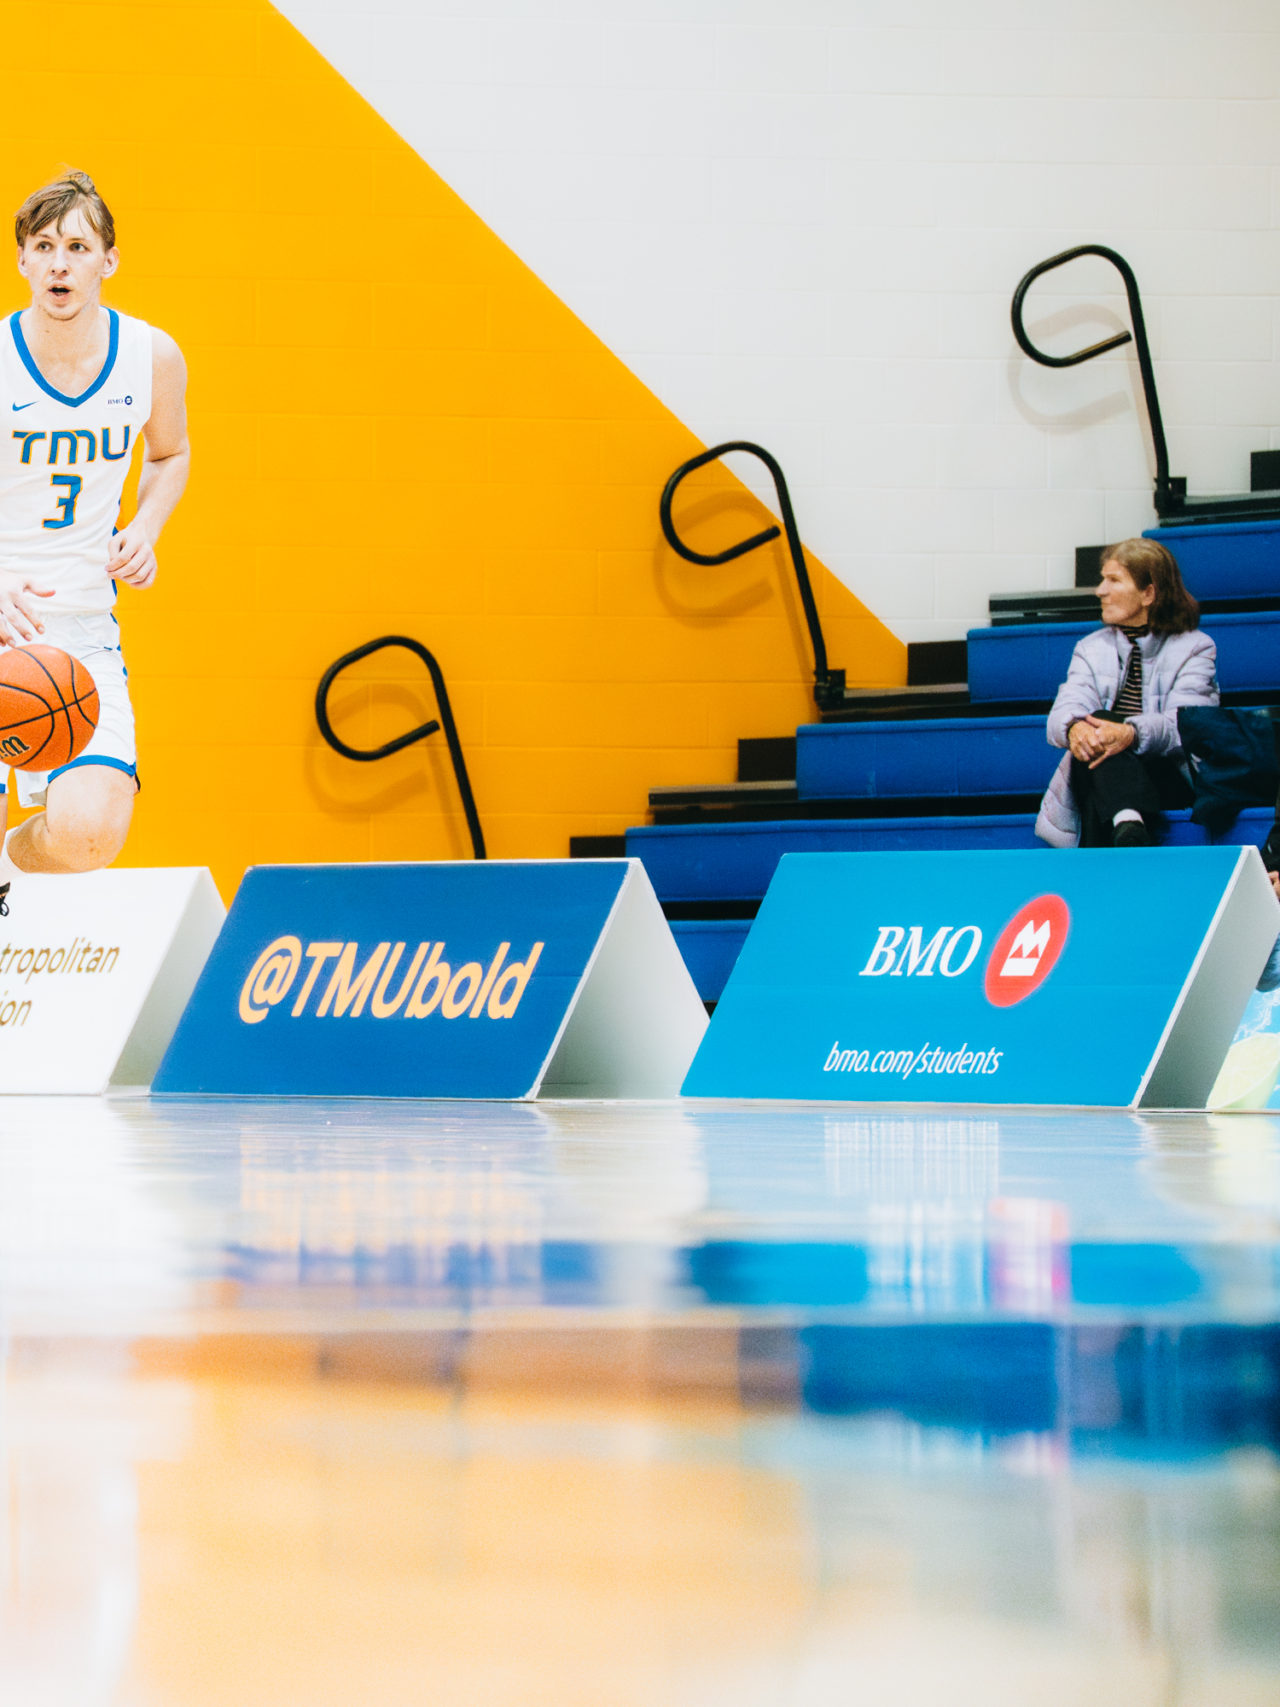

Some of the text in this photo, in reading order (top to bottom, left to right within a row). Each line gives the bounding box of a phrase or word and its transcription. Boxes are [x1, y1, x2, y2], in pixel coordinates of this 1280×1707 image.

[11, 424, 131, 465] TMU
[41, 472, 83, 529] 3
[858, 925, 983, 978] BMO
[238, 935, 545, 1024] @TMUbold
[823, 1041, 1004, 1081] bmo.com/students
